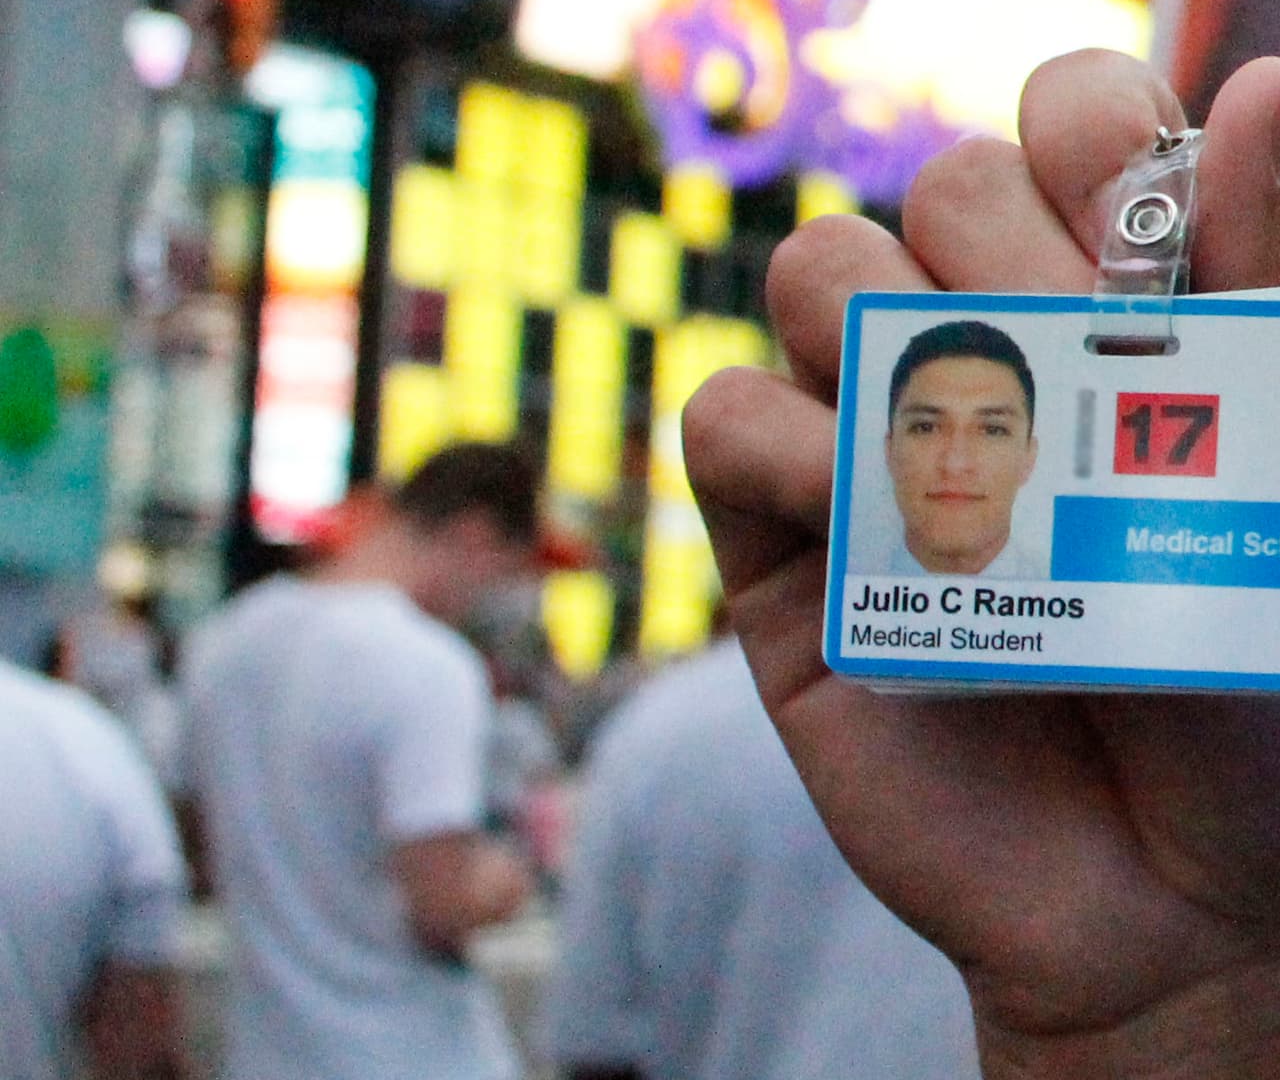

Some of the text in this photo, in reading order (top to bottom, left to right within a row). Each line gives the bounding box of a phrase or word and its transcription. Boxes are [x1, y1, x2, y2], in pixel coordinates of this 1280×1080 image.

[1121, 404, 1214, 465] 17
[1126, 527, 1234, 555] Medical
[853, 585, 1085, 619] Julio C Ramos
[851, 625, 1043, 652] Medical Student
